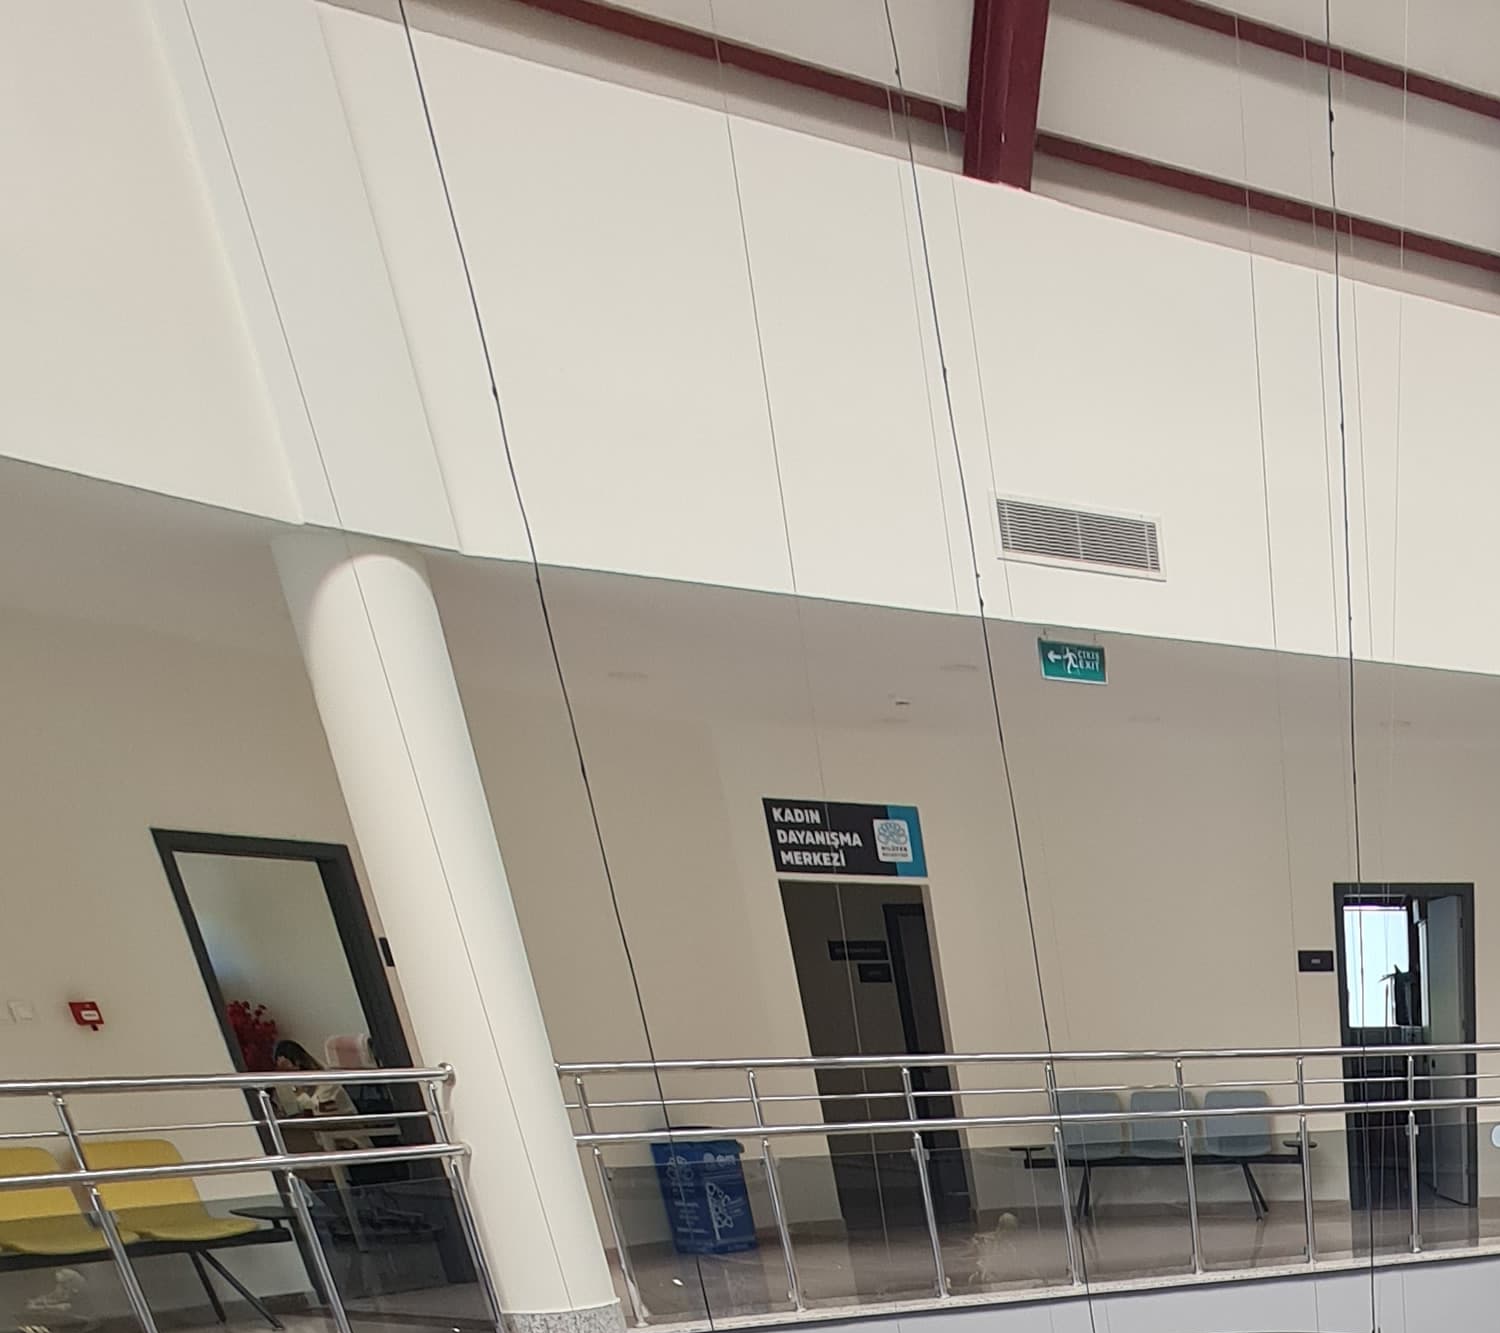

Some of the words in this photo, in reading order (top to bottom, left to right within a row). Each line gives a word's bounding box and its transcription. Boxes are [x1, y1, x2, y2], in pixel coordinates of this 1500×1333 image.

[772, 806, 821, 824] KADIN
[776, 828, 863, 848] DAYANIŞMA
[780, 849, 846, 867] MERKEZİ
